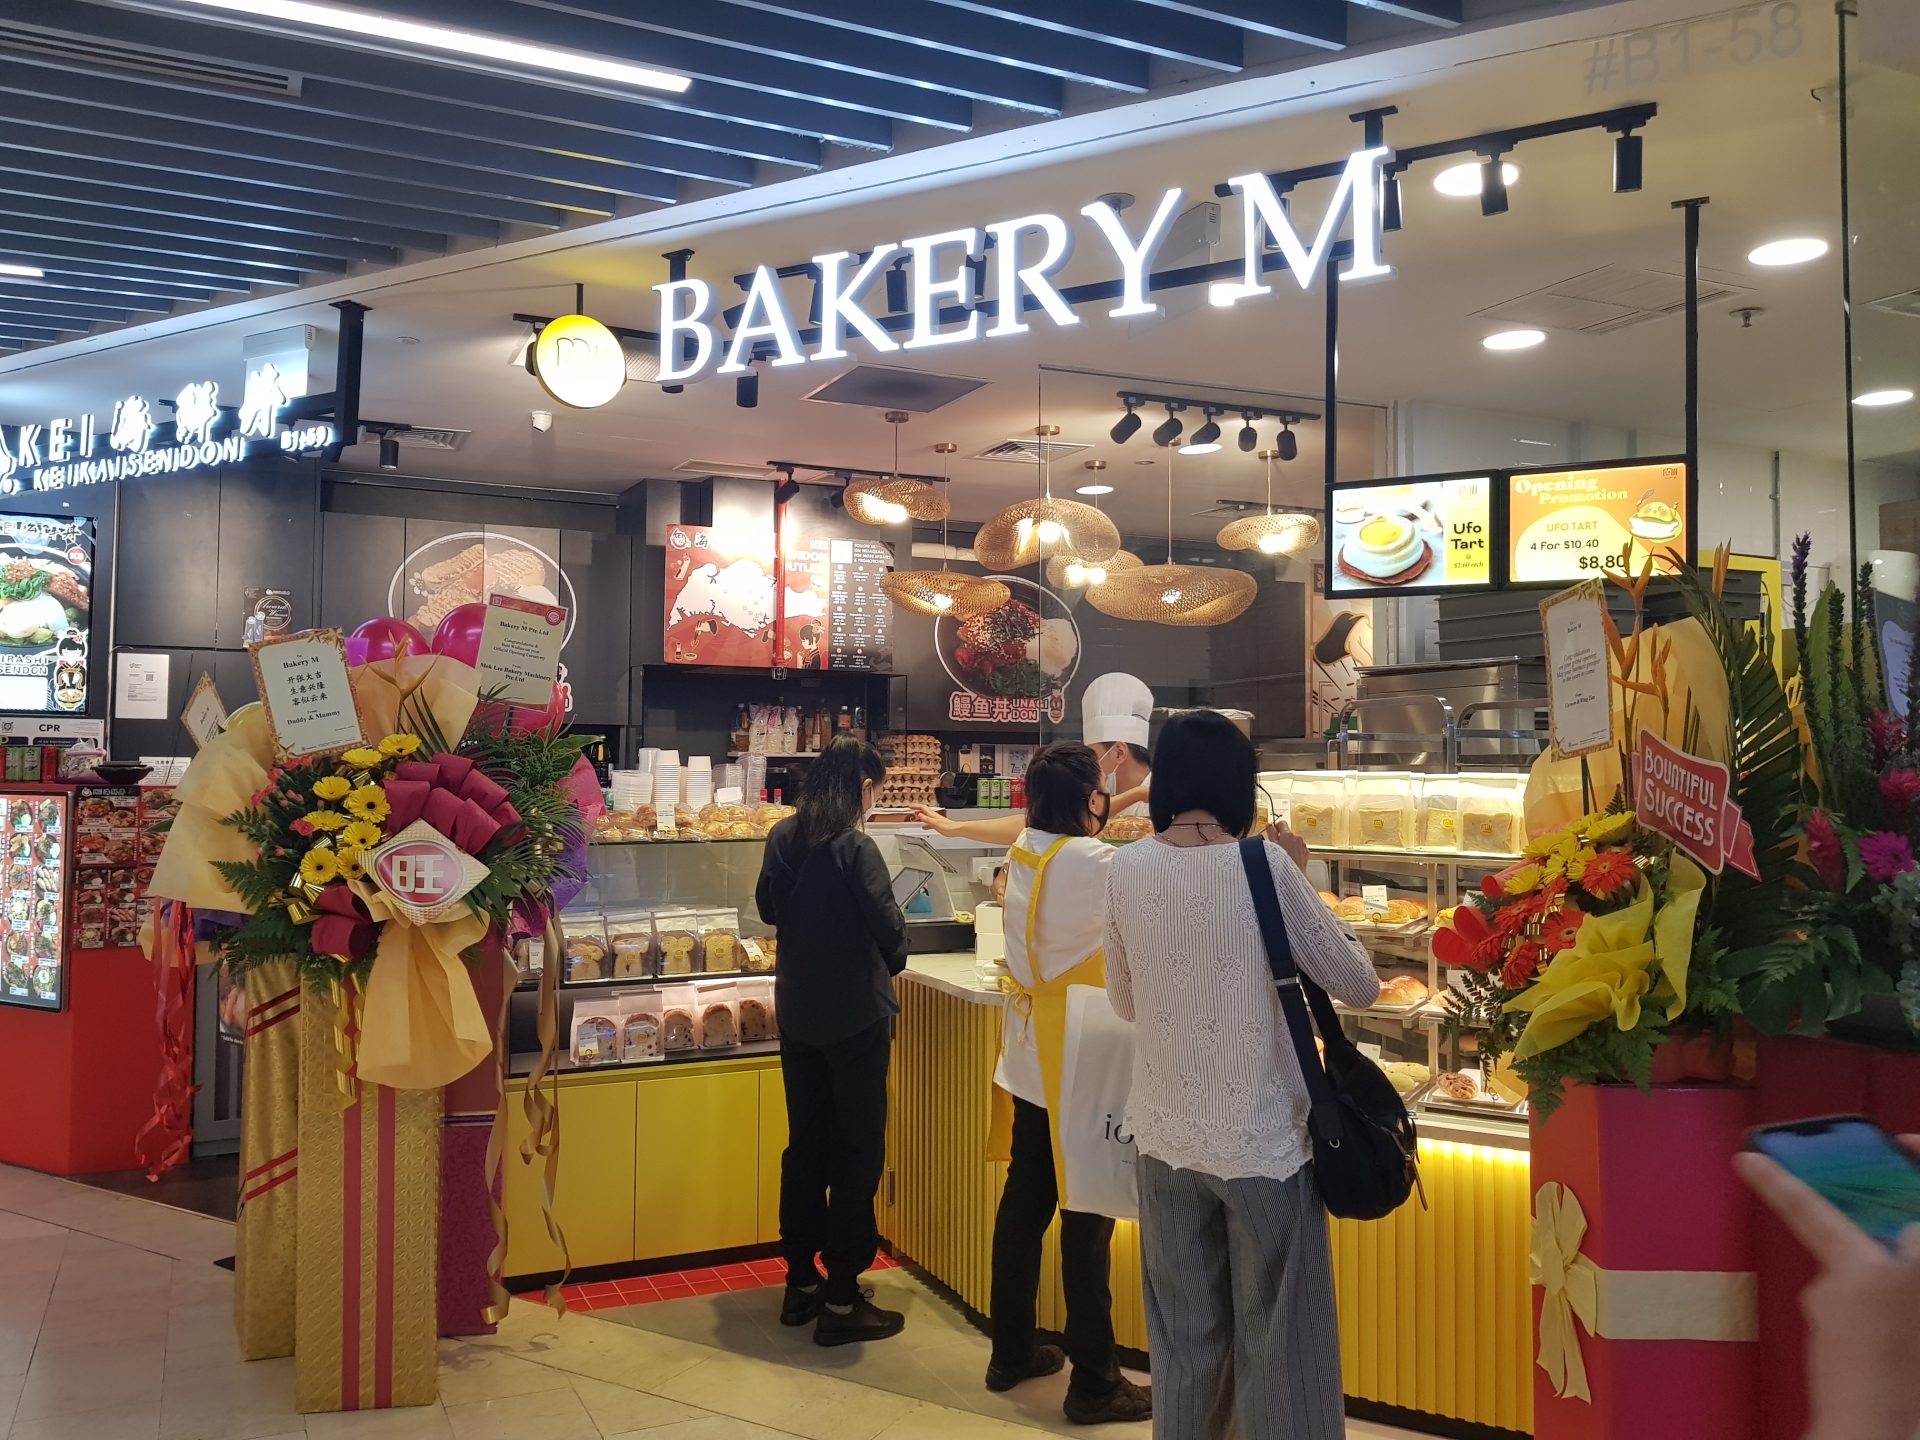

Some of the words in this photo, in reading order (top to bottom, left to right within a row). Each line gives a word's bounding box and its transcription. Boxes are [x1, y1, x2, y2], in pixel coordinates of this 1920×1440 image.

[1584, 2, 1801, 95] #B1-58
[652, 188, 1183, 384] BAKERY
[1231, 146, 1398, 300] M
[18, 413, 96, 468] KEI
[1515, 475, 1599, 497] Opening
[1539, 489, 1629, 504] Promotion
[1453, 521, 1482, 535] Ufo
[1547, 522, 1569, 532] UFO
[1571, 521, 1598, 530] TART
[1450, 538, 1484, 550] Tart
[1530, 542, 1537, 551] 4
[1564, 539, 1599, 550] $10.40
[1579, 554, 1625, 570] $8.80
[283, 660, 309, 669] Bakery
[311, 656, 319, 664] M
[287, 670, 322, 684] 开张大吉
[290, 681, 325, 695] 生意兴隆
[287, 717, 307, 725] Daddy
[316, 710, 340, 719] Mummy
[1012, 709, 1038, 720] DON
[38, 724, 61, 732] CPR
[1644, 745, 1717, 811] BOUNTIFUL
[1644, 778, 1714, 847] SUCCESS
[391, 854, 445, 894] 旺
